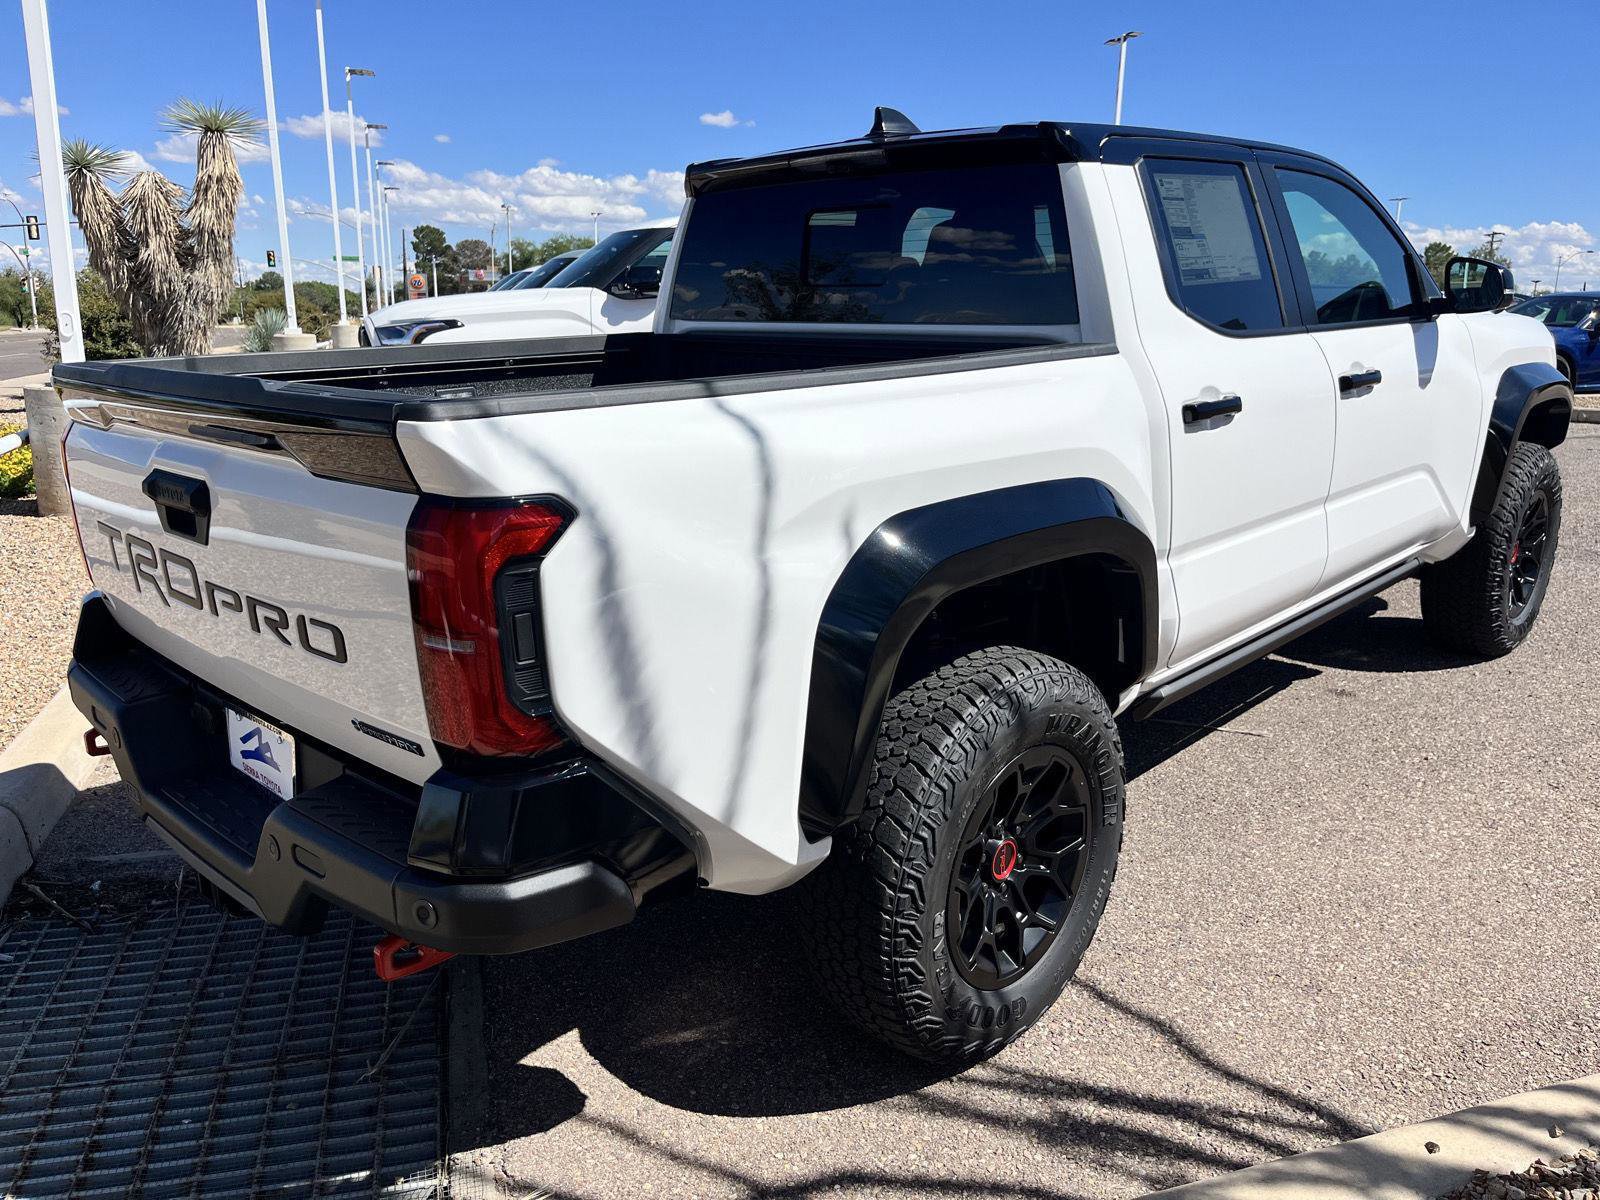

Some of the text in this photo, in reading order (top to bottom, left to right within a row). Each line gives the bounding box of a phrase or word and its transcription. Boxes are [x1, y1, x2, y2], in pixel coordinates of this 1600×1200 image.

[97, 520, 348, 664] TRD PRO
[1044, 713, 1119, 828] WRANGLER
